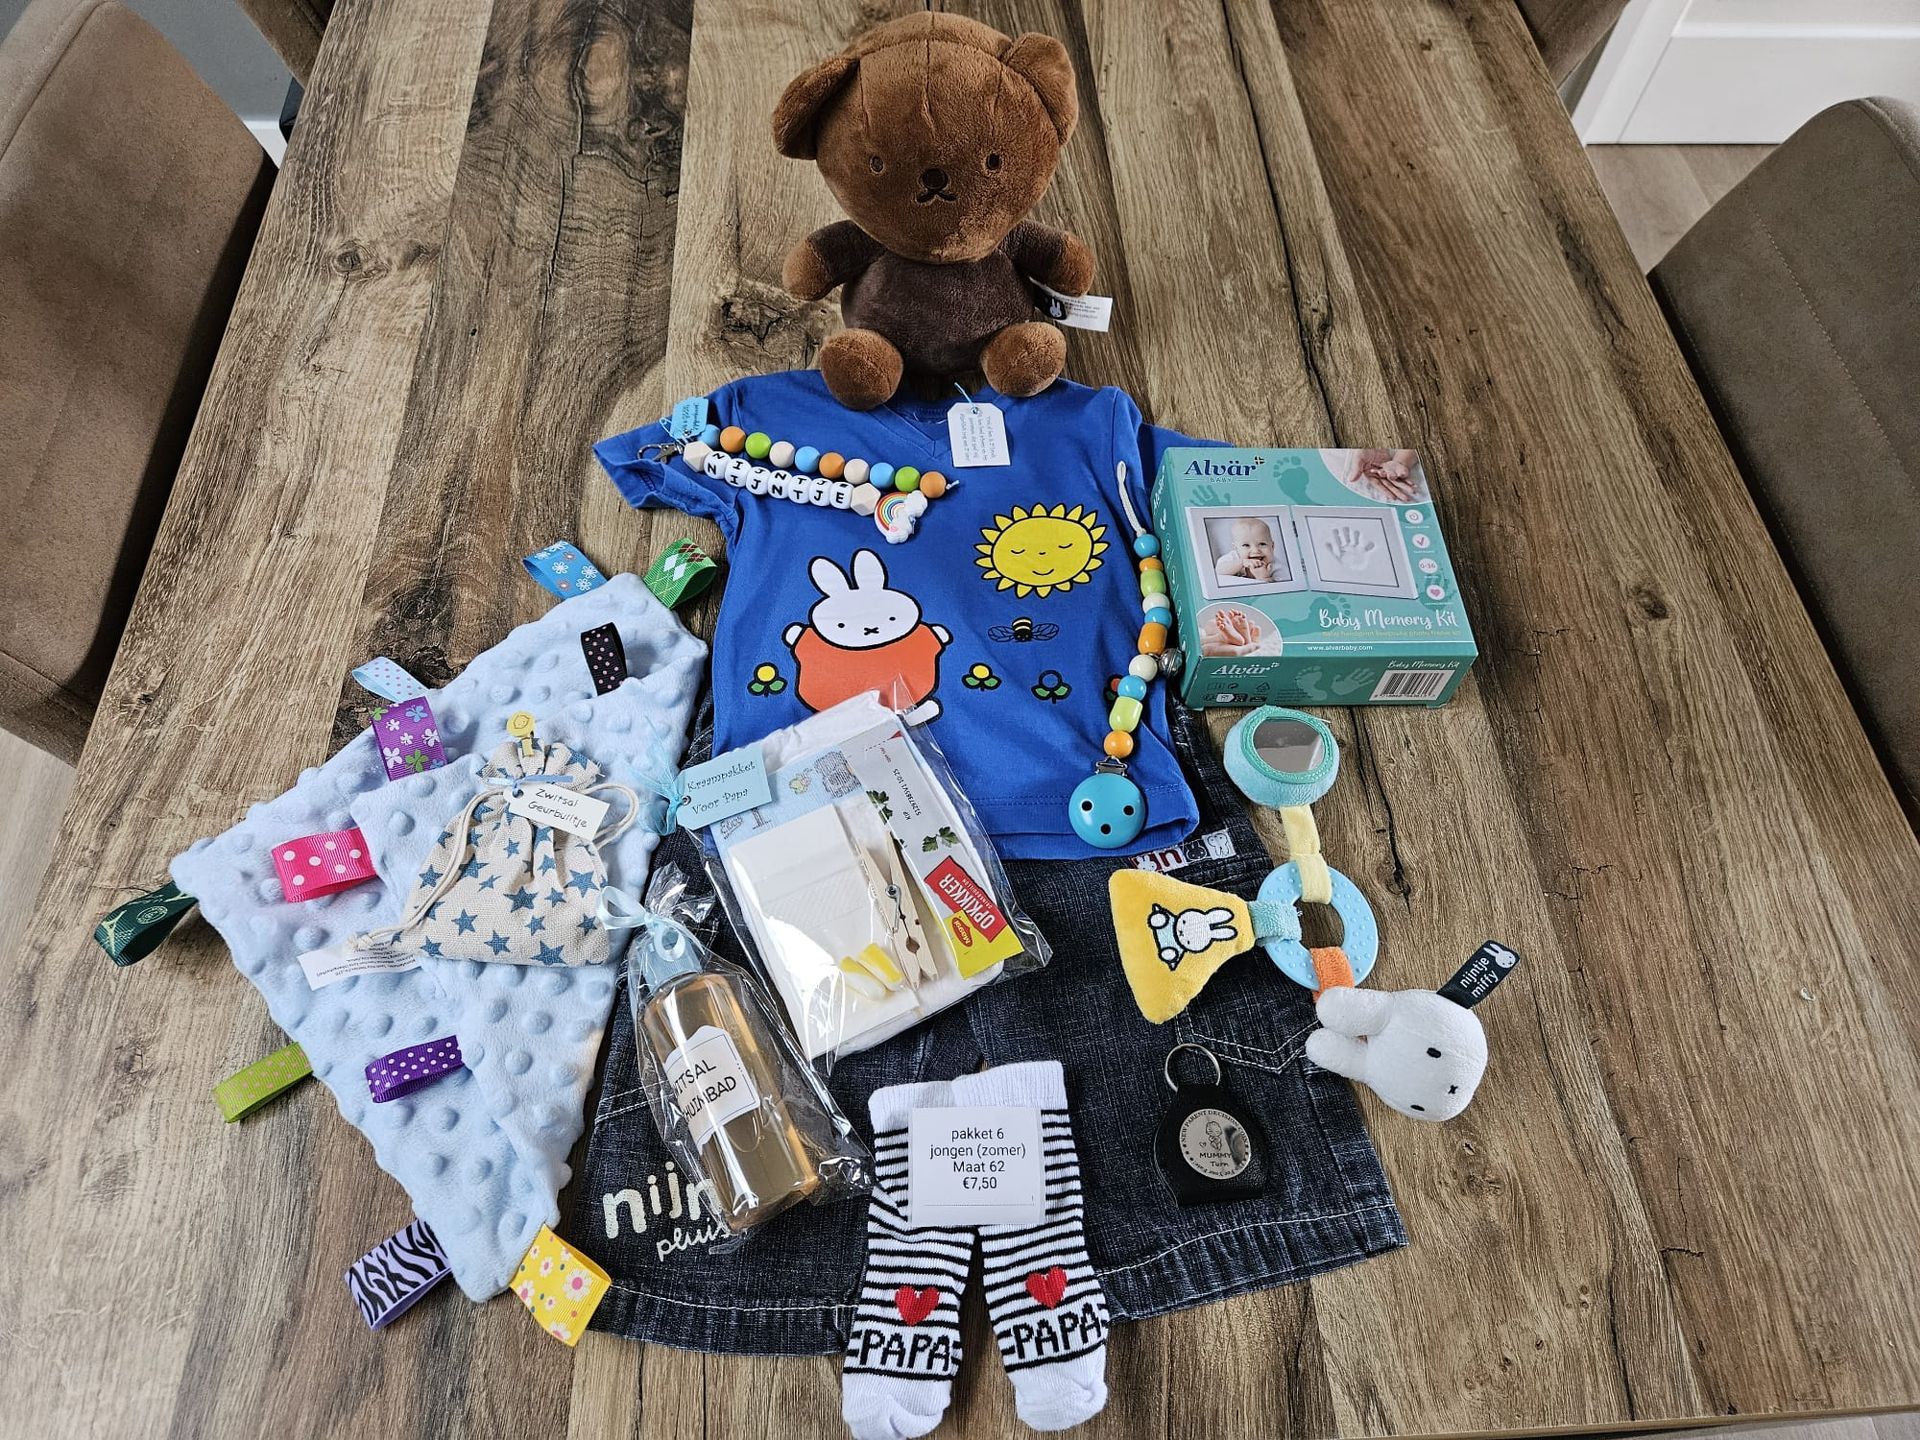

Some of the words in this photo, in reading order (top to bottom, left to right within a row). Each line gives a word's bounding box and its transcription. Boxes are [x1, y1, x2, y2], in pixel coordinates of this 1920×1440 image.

[1184, 460, 1256, 476] Alvär
[707, 463, 844, 504] NIJNTJE
[1318, 608, 1361, 631] Baby
[1364, 608, 1433, 630] Memory
[1436, 609, 1460, 627] Kit
[1210, 664, 1271, 675] Alvär
[1388, 660, 1410, 669] Baby
[1412, 660, 1446, 669] Memory
[535, 788, 578, 808] Zwitsal
[692, 799, 720, 815] Voor
[722, 788, 748, 804] Papa
[938, 874, 996, 930] OPKIKKER
[1460, 957, 1490, 988] nijntje
[1471, 970, 1498, 998] miffy
[1184, 1110, 1206, 1128] PARENT
[951, 1127, 993, 1142] pakket
[996, 1128, 1004, 1140] 6
[930, 1144, 973, 1160] jongen
[976, 1142, 1026, 1159] (zomer)
[953, 1161, 986, 1172] Maat
[989, 1160, 1006, 1172] 62
[962, 1176, 998, 1190] €7,50
[1012, 1302, 1102, 1360] PAPA
[860, 1329, 953, 1372] PAPA
